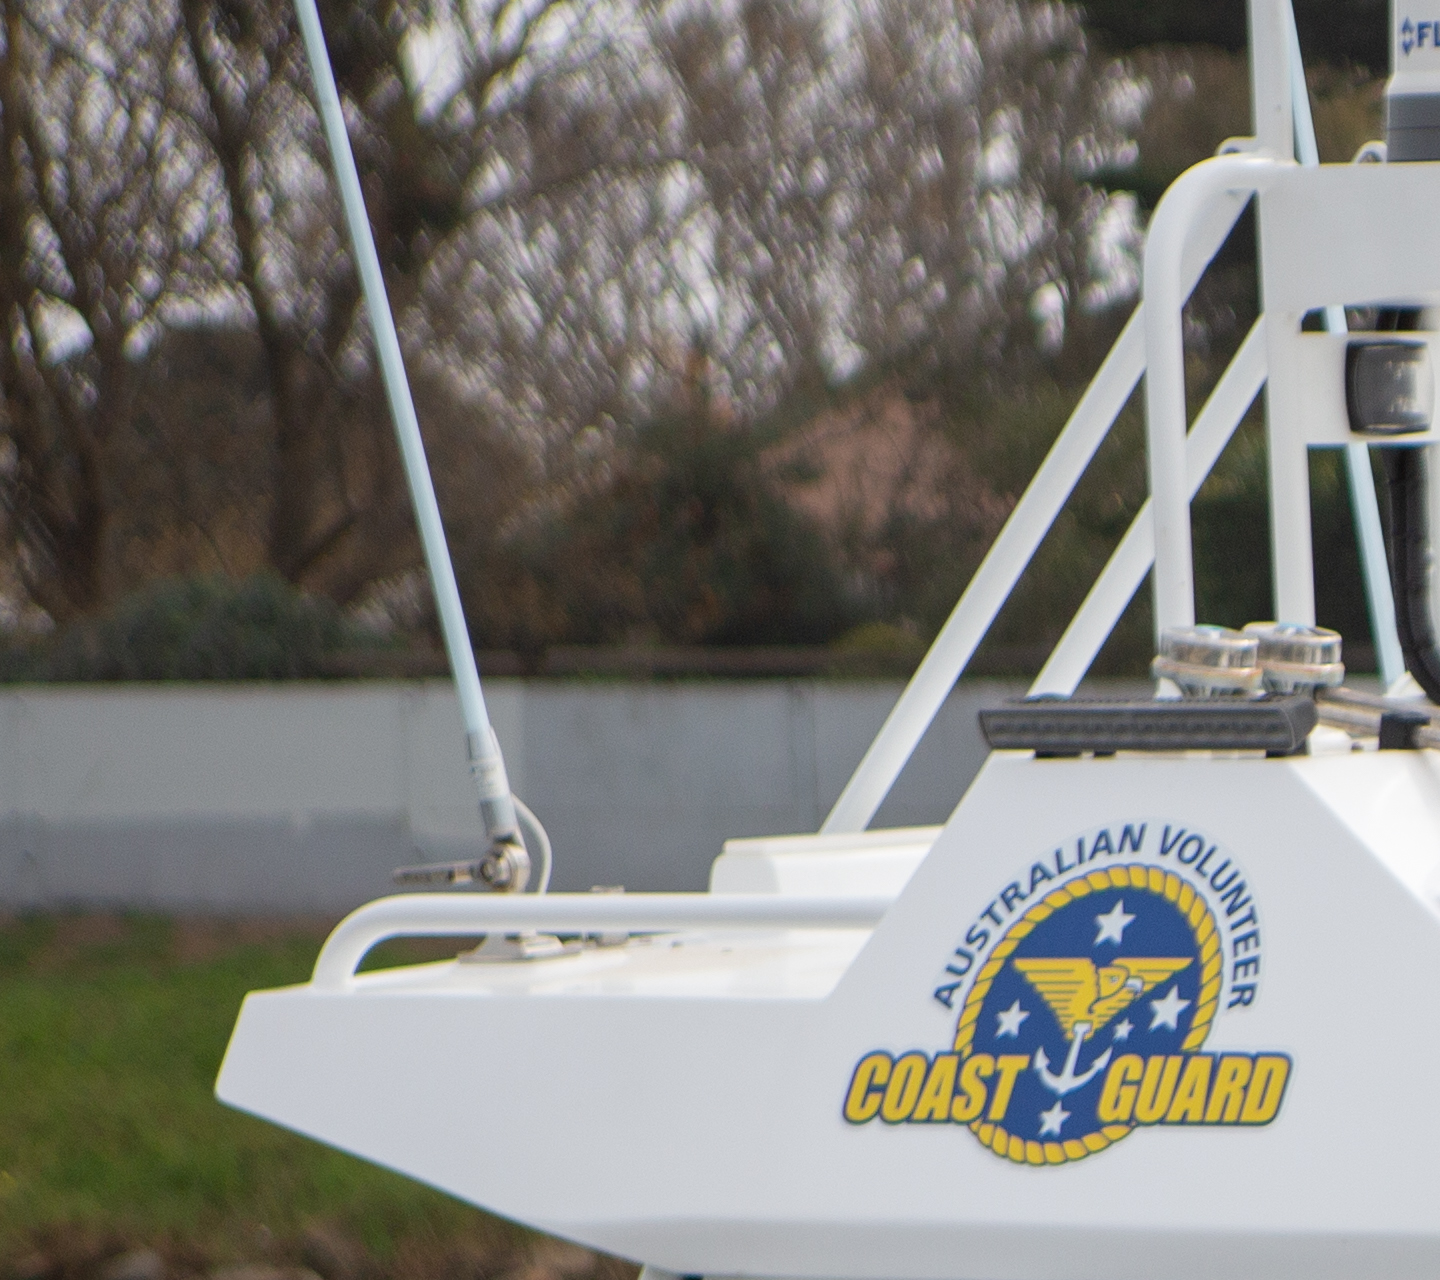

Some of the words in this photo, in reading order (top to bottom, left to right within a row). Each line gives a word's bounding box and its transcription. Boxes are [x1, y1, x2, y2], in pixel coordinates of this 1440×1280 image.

[932, 822, 1148, 1011] AUSTRALIAN
[1157, 824, 1263, 1010] VOLUNTEER
[843, 1050, 1032, 1125] COAST
[1097, 1052, 1294, 1126] GUARD
